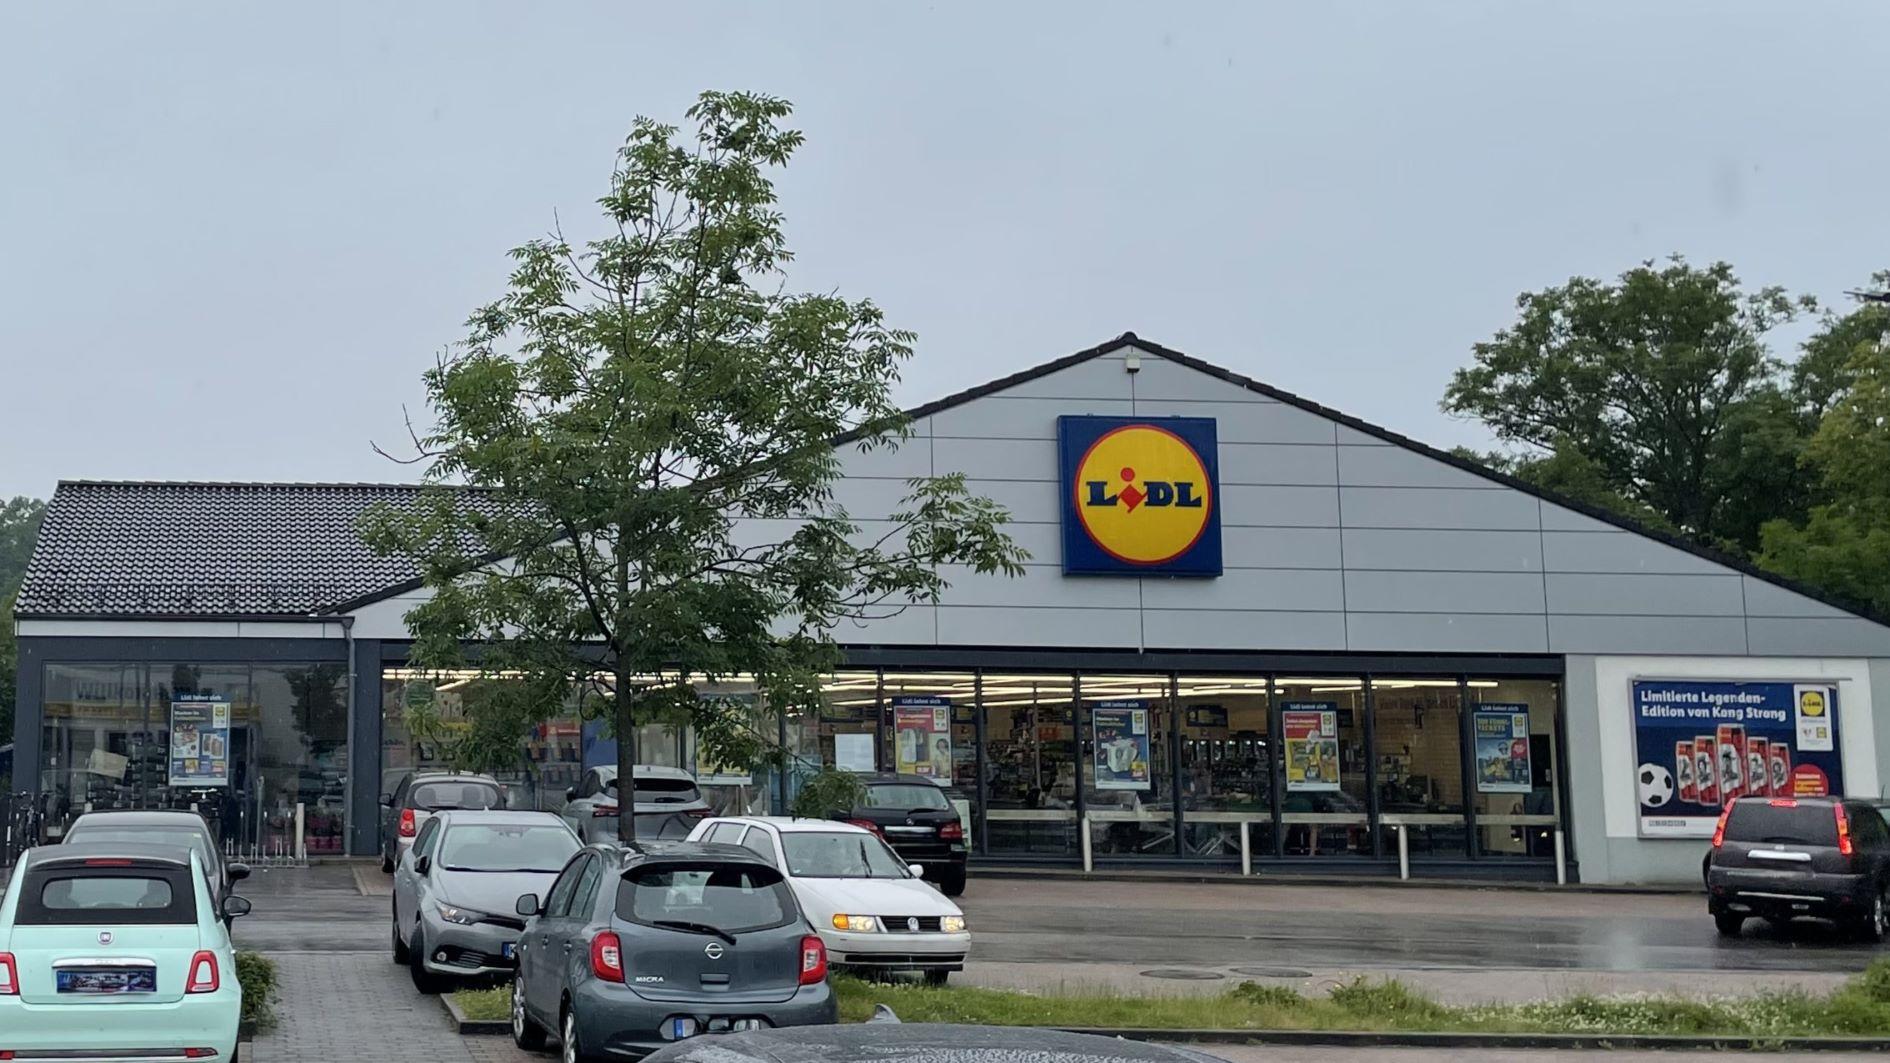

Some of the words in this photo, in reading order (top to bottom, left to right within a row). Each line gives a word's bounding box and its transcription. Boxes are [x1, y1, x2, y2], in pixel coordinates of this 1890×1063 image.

[1085, 467, 1203, 514] LIDL
[1641, 690, 1699, 702] Limitierte
[1701, 691, 1766, 705] Legenden-
[1641, 705, 1685, 717] Edition
